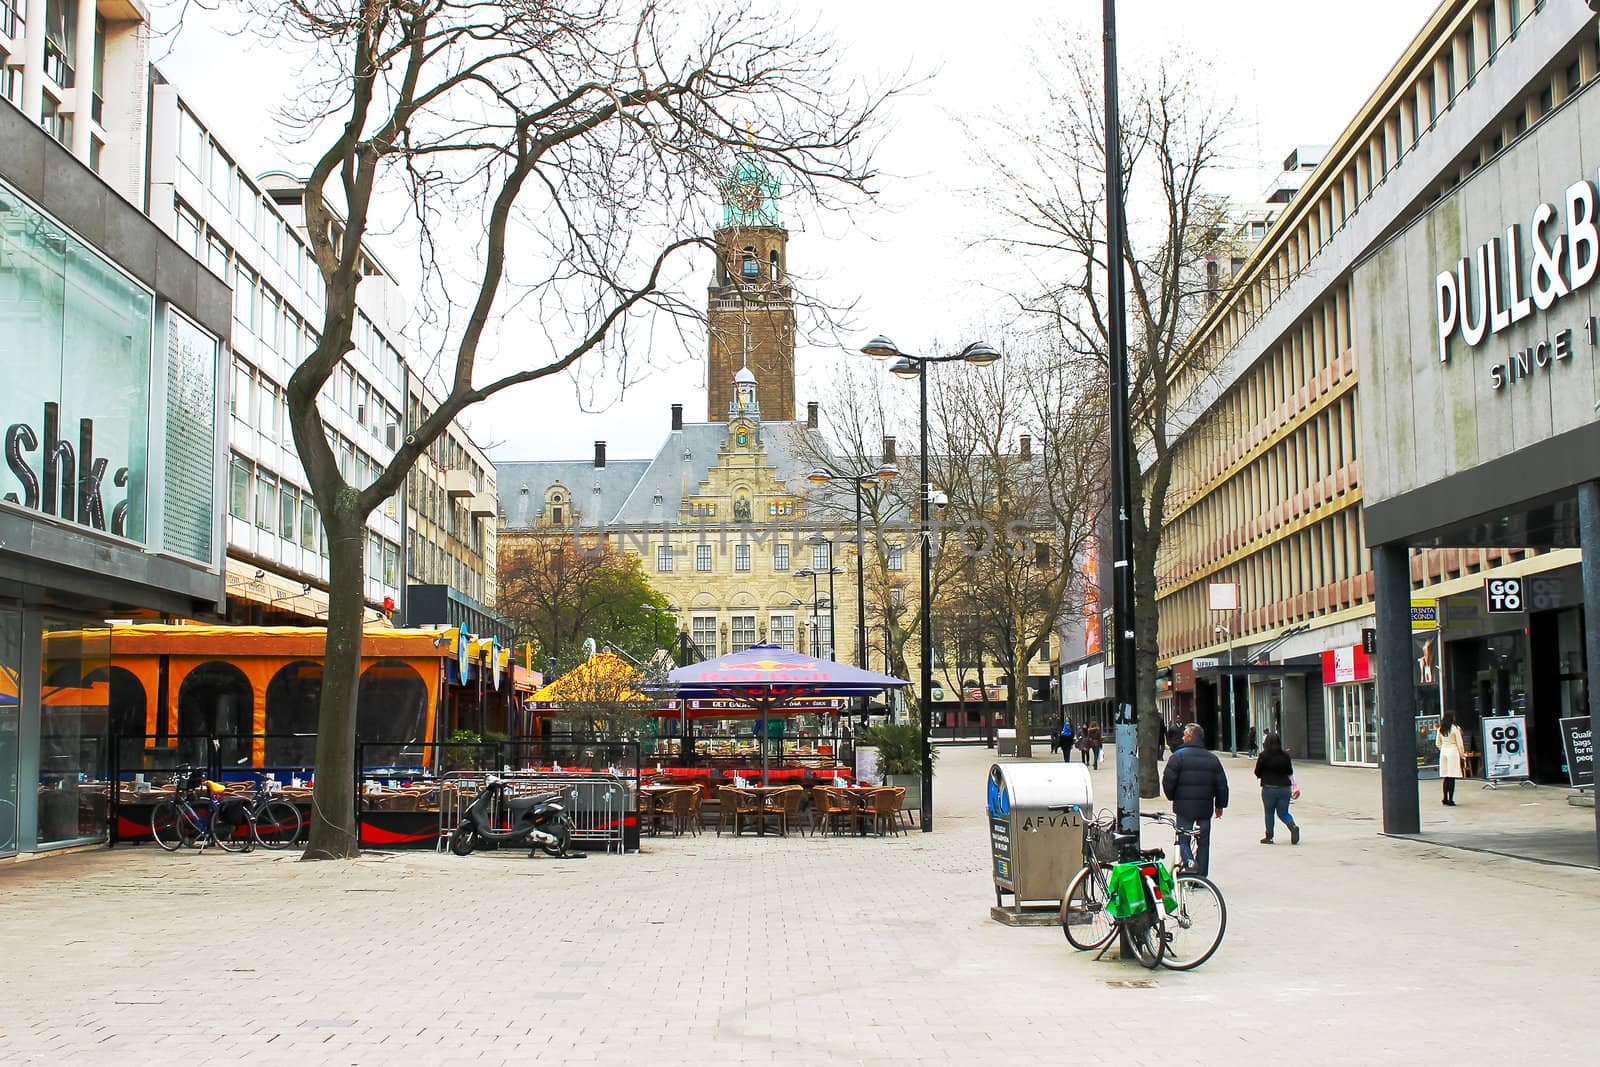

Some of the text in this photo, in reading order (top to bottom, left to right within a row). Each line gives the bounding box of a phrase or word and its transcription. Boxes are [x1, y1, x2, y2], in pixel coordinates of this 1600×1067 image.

[1435, 168, 1600, 363] PULL&B
[1490, 328, 1572, 390] SINCE
[1490, 580, 1520, 595] GO
[1490, 595, 1521, 610] TO
[1491, 726, 1518, 740] GO
[1492, 740, 1520, 754] TO
[1573, 739, 1591, 747] bags
[1023, 815, 1080, 828] AFVAL
